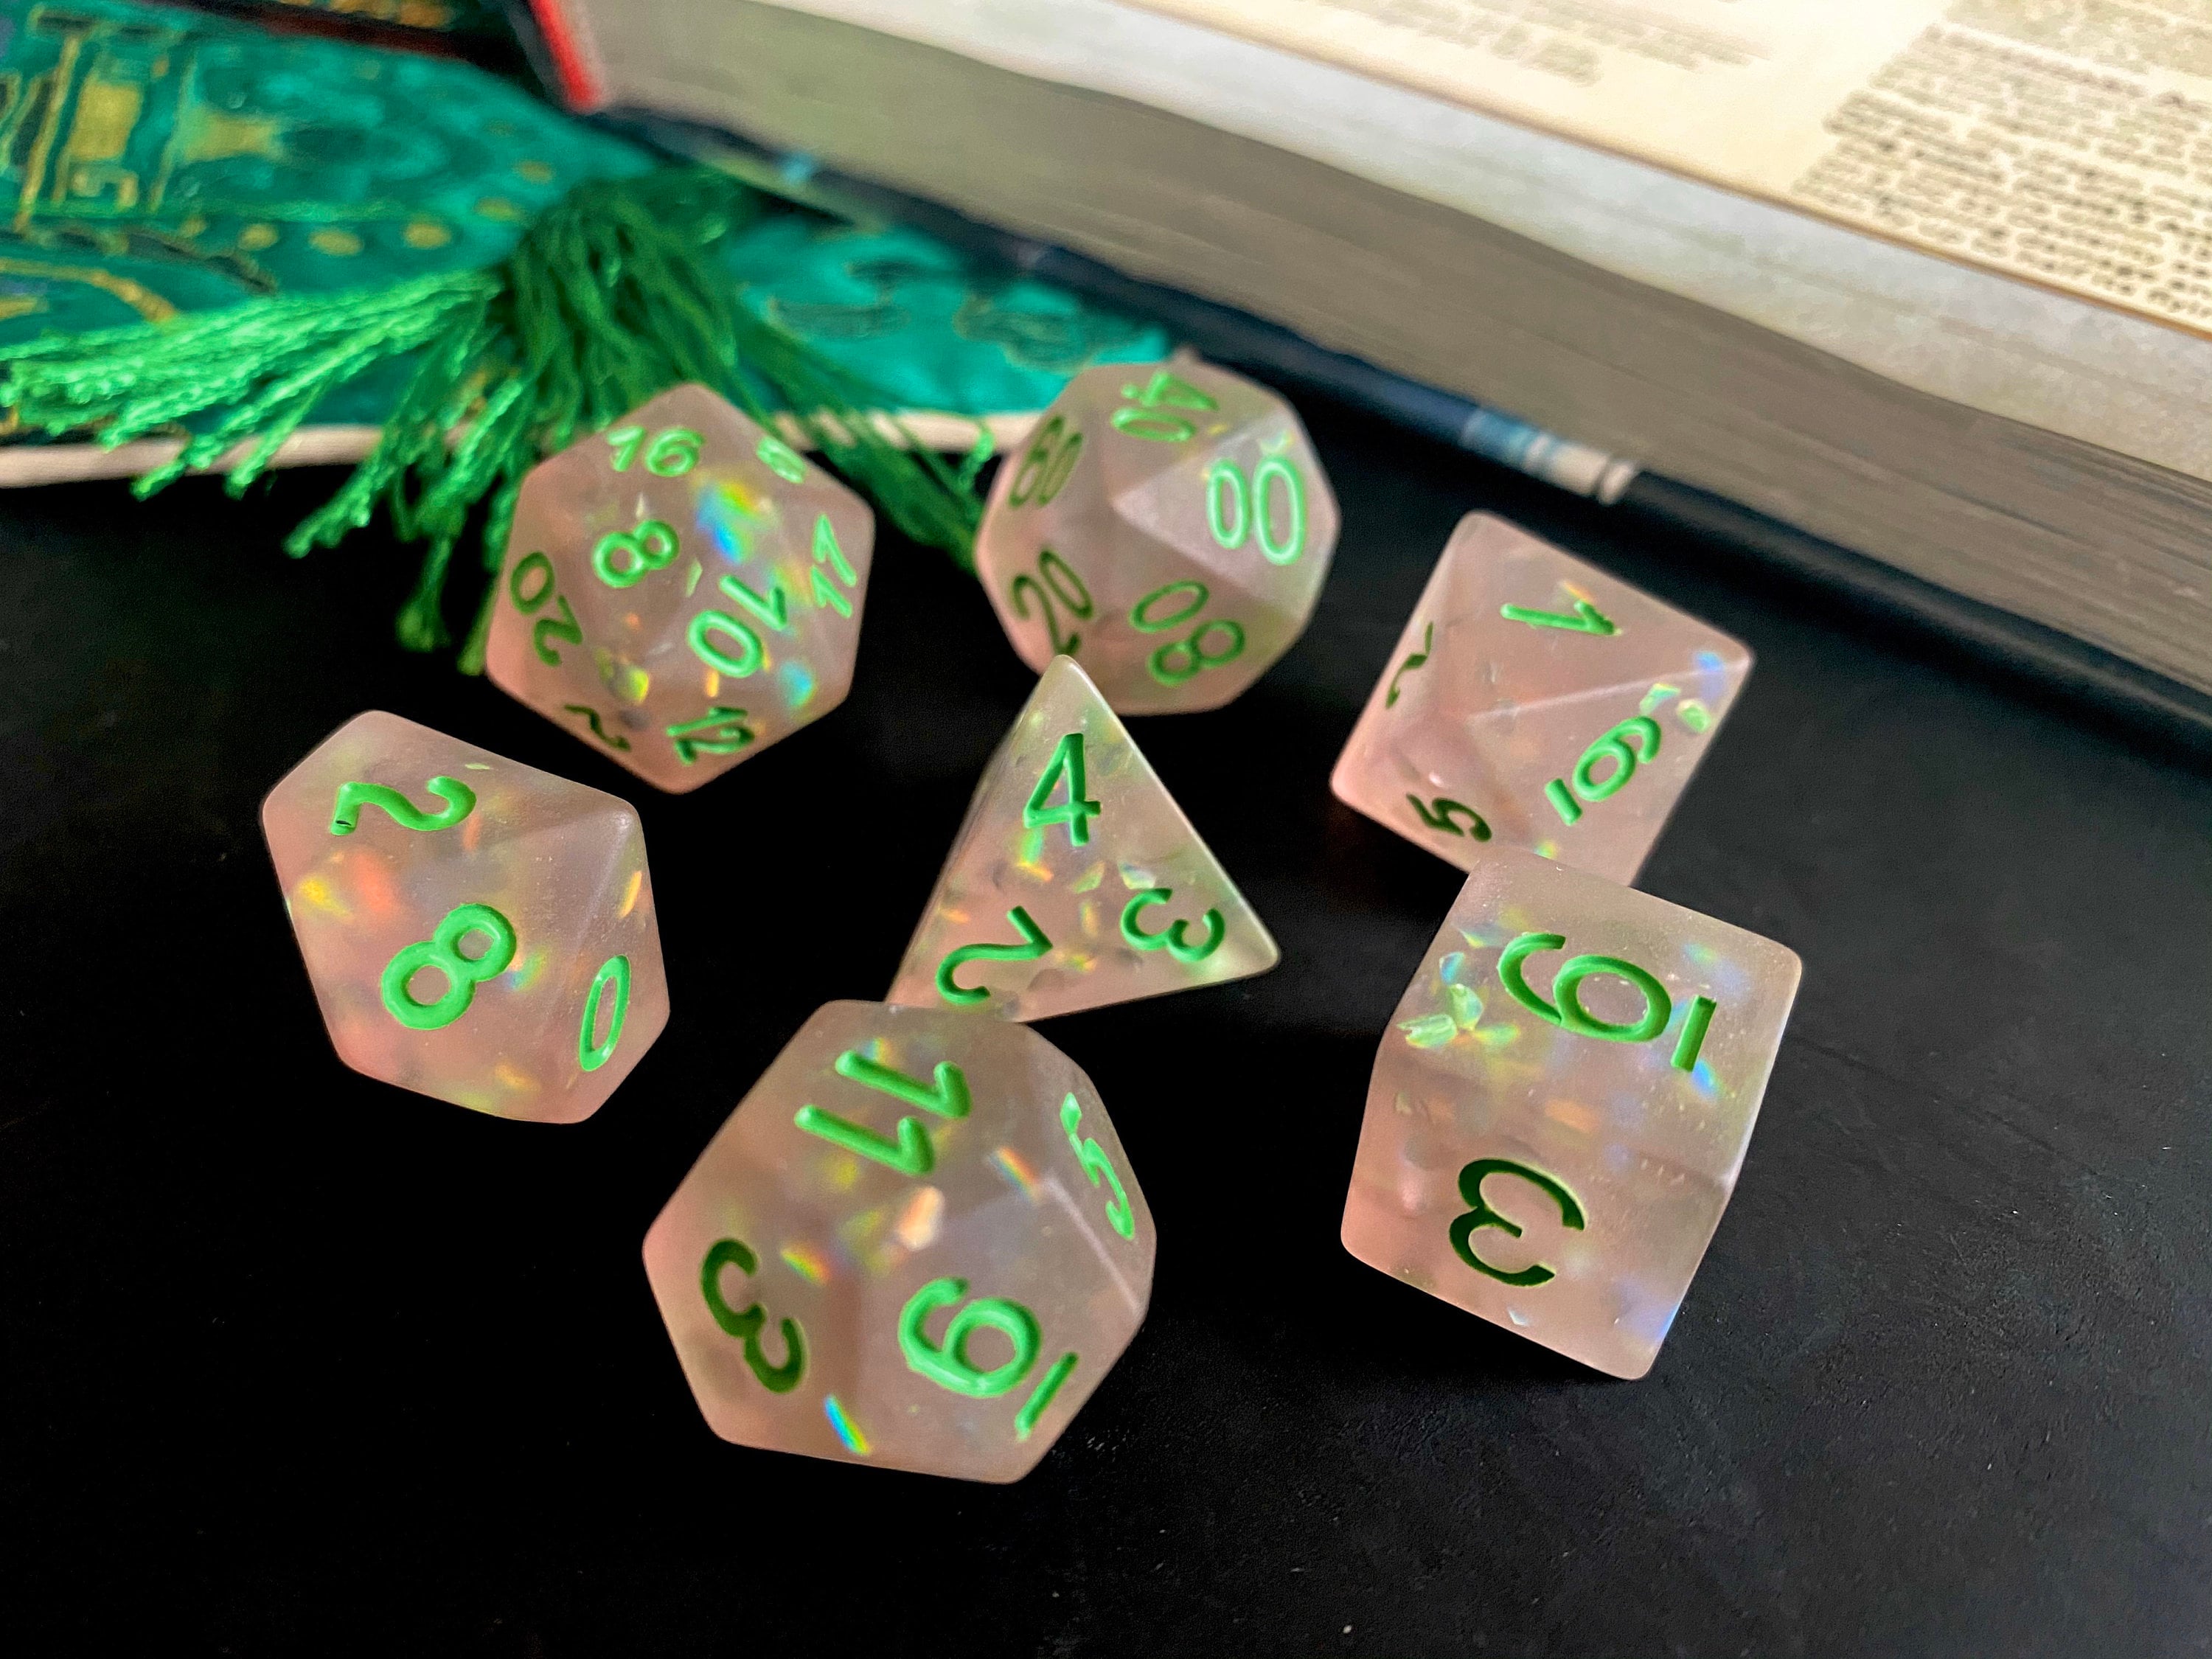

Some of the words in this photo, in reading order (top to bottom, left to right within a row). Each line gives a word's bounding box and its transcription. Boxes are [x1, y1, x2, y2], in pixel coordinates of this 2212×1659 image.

[606, 425, 706, 478] 16
[593, 519, 680, 588] 8
[1206, 455, 1307, 566] 00
[509, 552, 583, 667] 20
[686, 574, 787, 678] 10
[1010, 549, 1094, 656] 20
[1128, 580, 1246, 686] 80
[1500, 601, 1618, 636] 1
[665, 706, 756, 765] 12
[330, 776, 477, 836] 2
[1023, 732, 1102, 848] 4
[1405, 793, 1492, 842] 5
[381, 902, 518, 1031] 8
[935, 905, 1054, 1006] 2
[1120, 887, 1225, 963] 3
[578, 954, 632, 1072] 0
[794, 1049, 972, 1177] 11
[1060, 1092, 1136, 1242] 5
[1449, 1156, 1586, 1287] 3
[700, 1238, 810, 1395] 3
